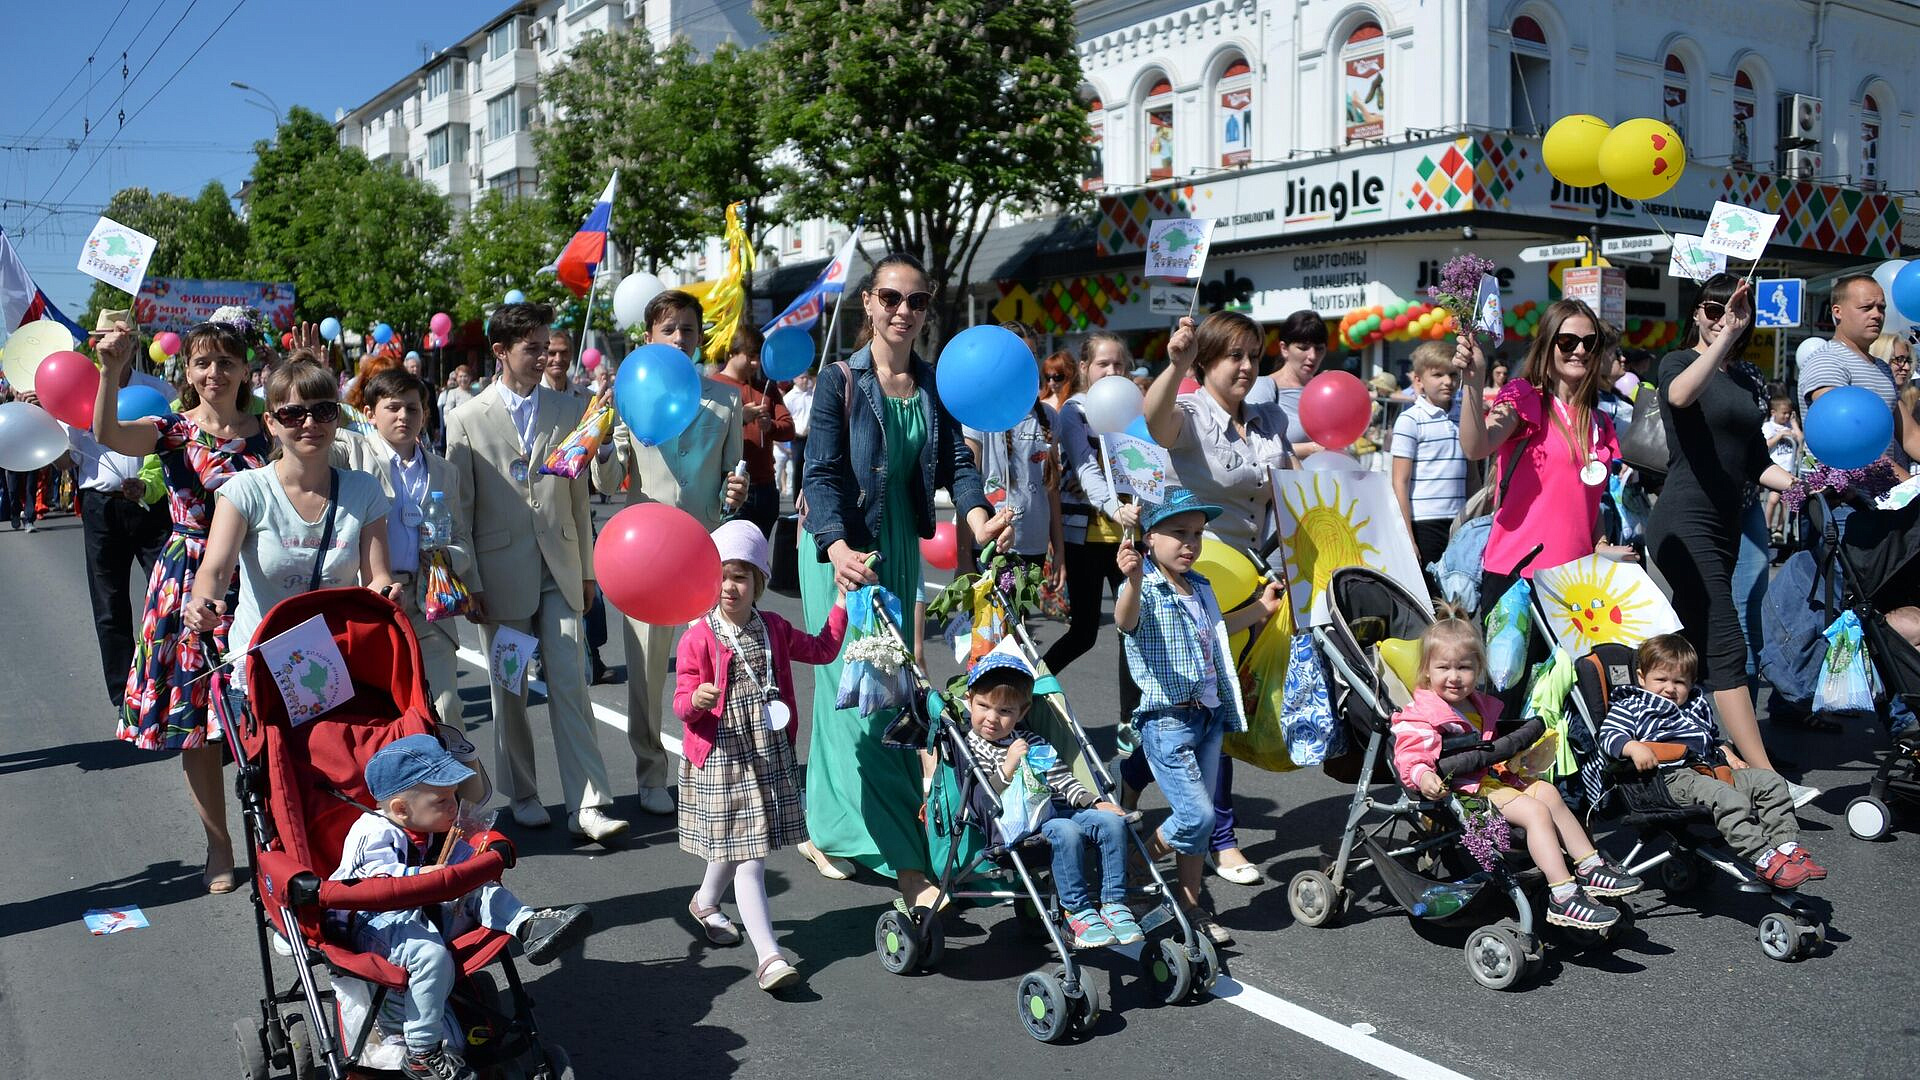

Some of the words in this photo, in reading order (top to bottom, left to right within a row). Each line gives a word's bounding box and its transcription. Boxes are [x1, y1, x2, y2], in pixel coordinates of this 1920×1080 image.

[1285, 170, 1384, 221] Jingle
[1552, 246, 1581, 256] Кирова
[1621, 238, 1653, 248] Кирова
[1293, 250, 1367, 271] СМАРТФОНЫ
[1303, 272, 1367, 289] ПЛАНШЕТЫ
[180, 295, 249, 304] ФИОЛЕНТ
[1310, 287, 1366, 310] НОУТБУКИ
